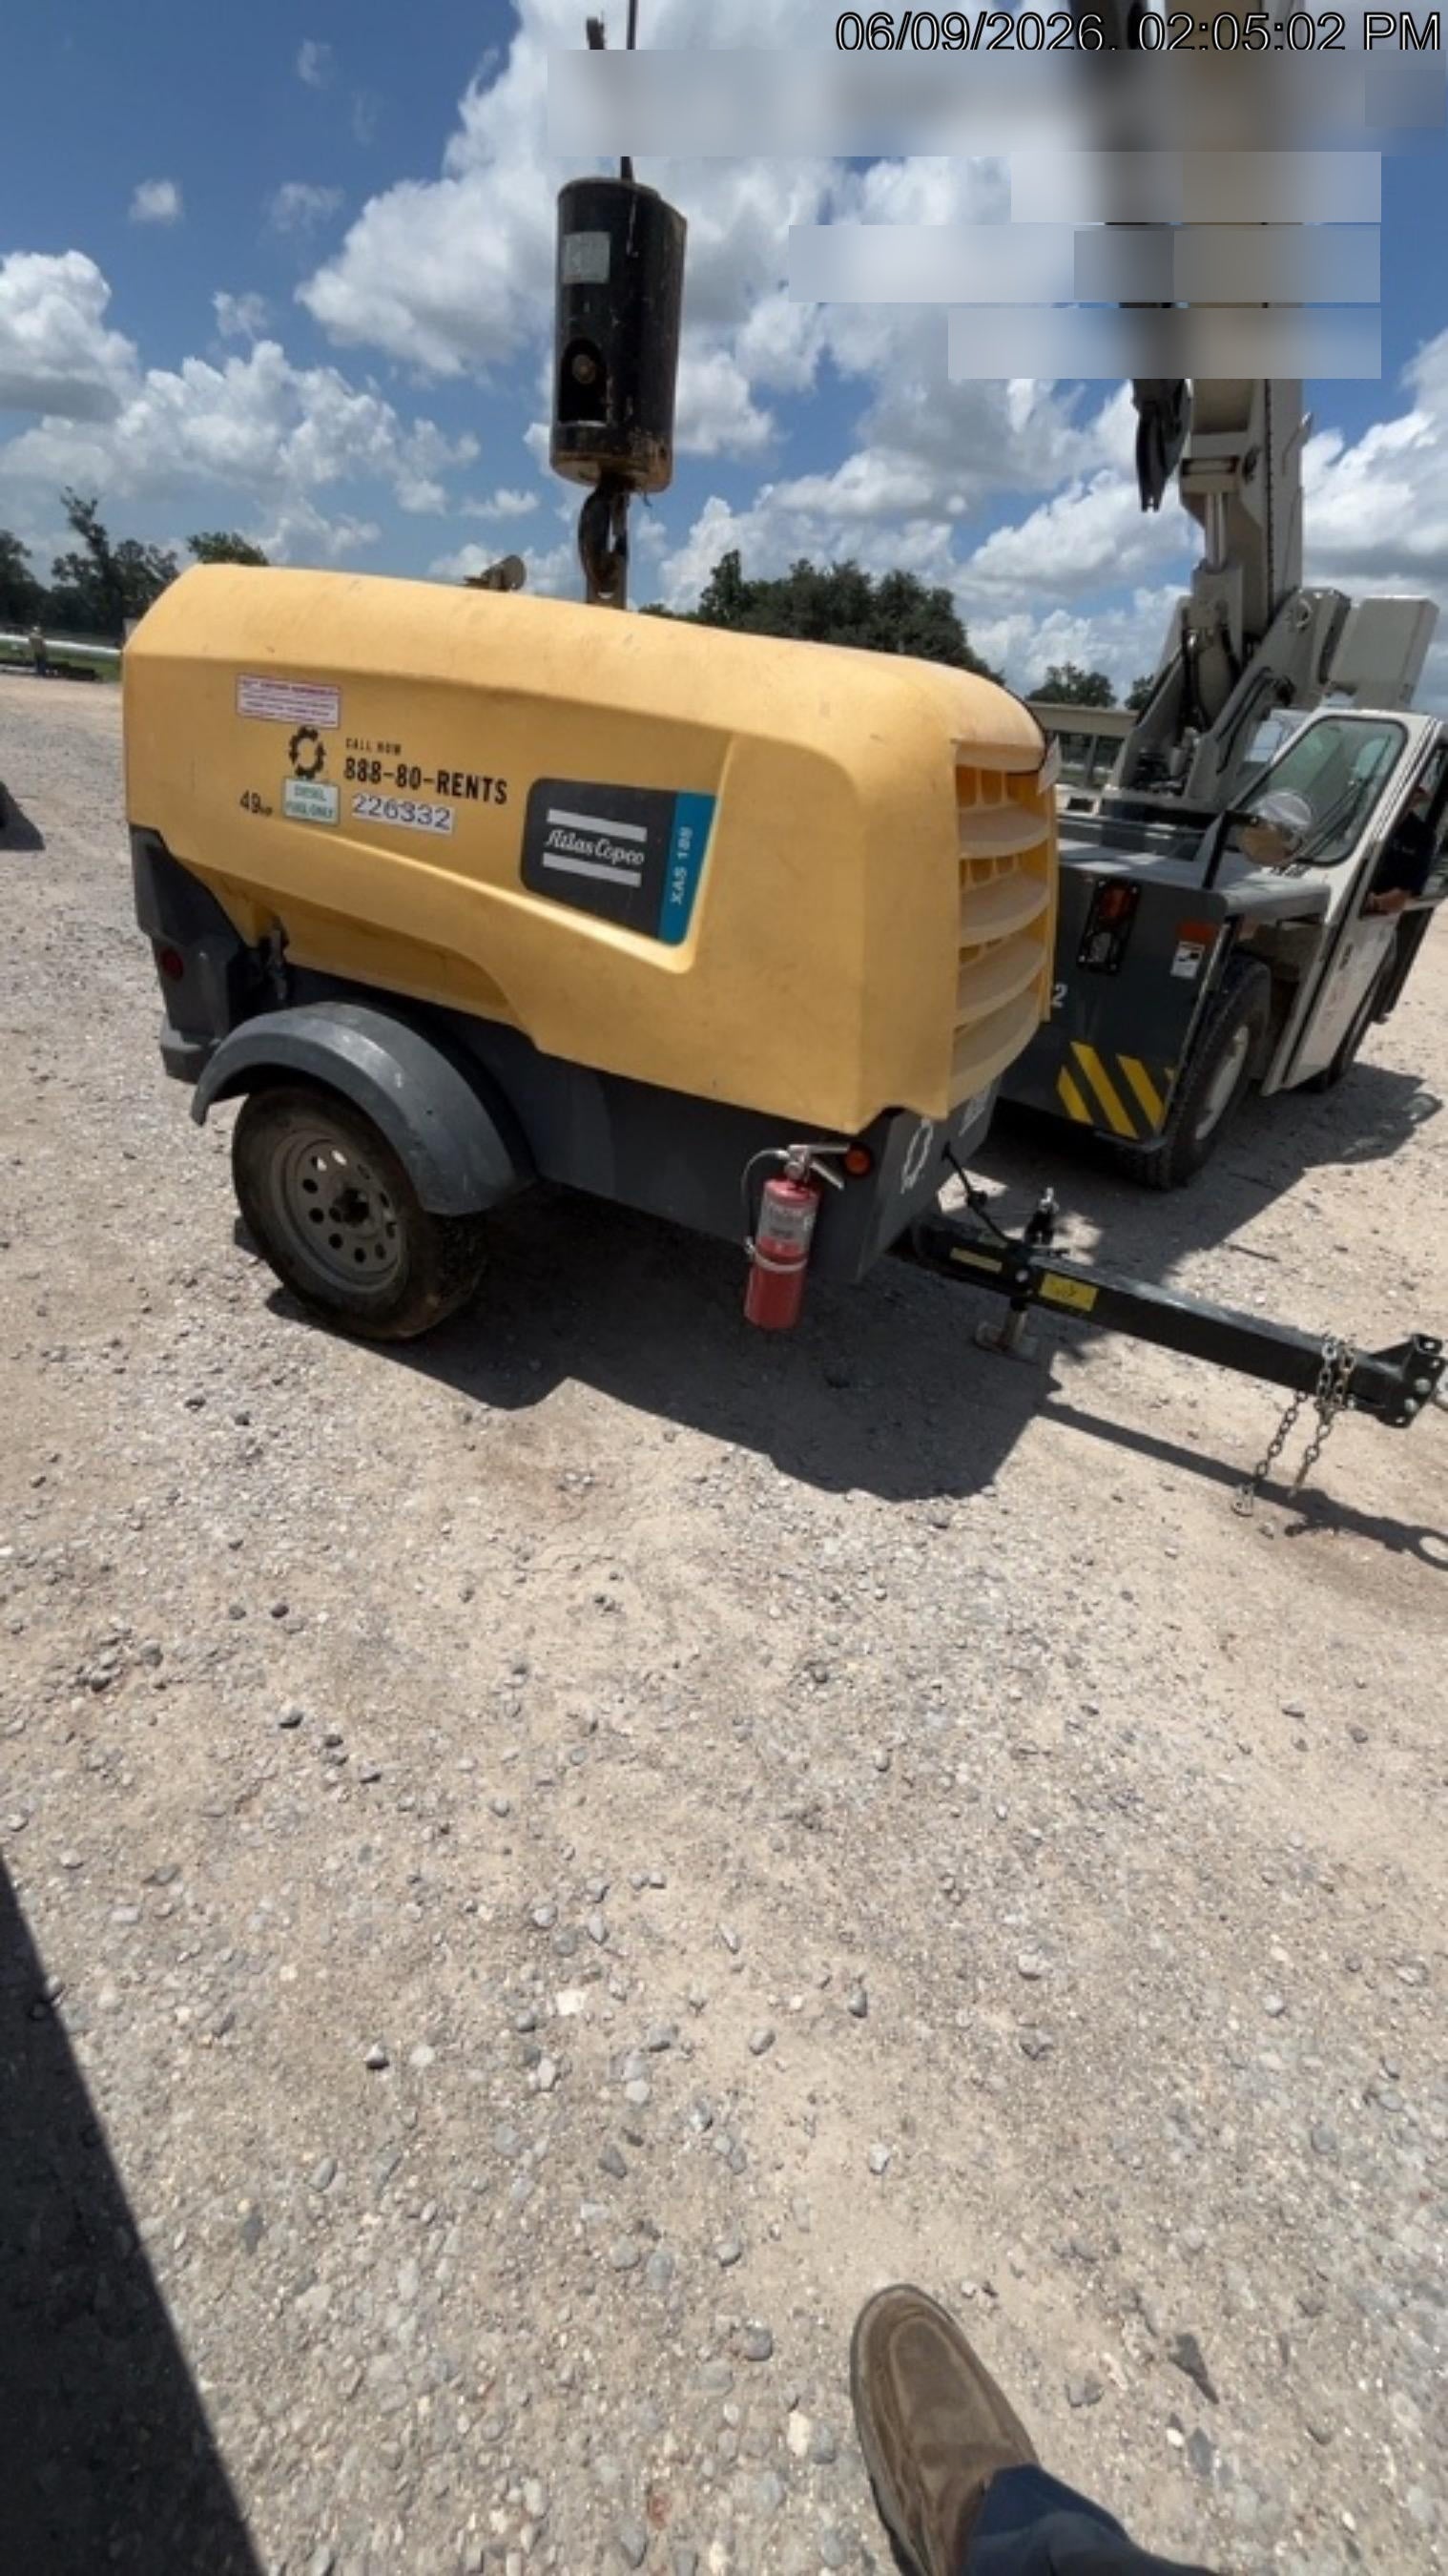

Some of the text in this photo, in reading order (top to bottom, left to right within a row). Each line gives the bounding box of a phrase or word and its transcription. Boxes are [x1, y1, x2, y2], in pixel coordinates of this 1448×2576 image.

[345, 737, 371, 753] CALL
[343, 757, 507, 805] 888-80-RENTS
[353, 792, 451, 831] 226332
[544, 828, 645, 866] Atlas Copco
[670, 866, 688, 905] XAS
